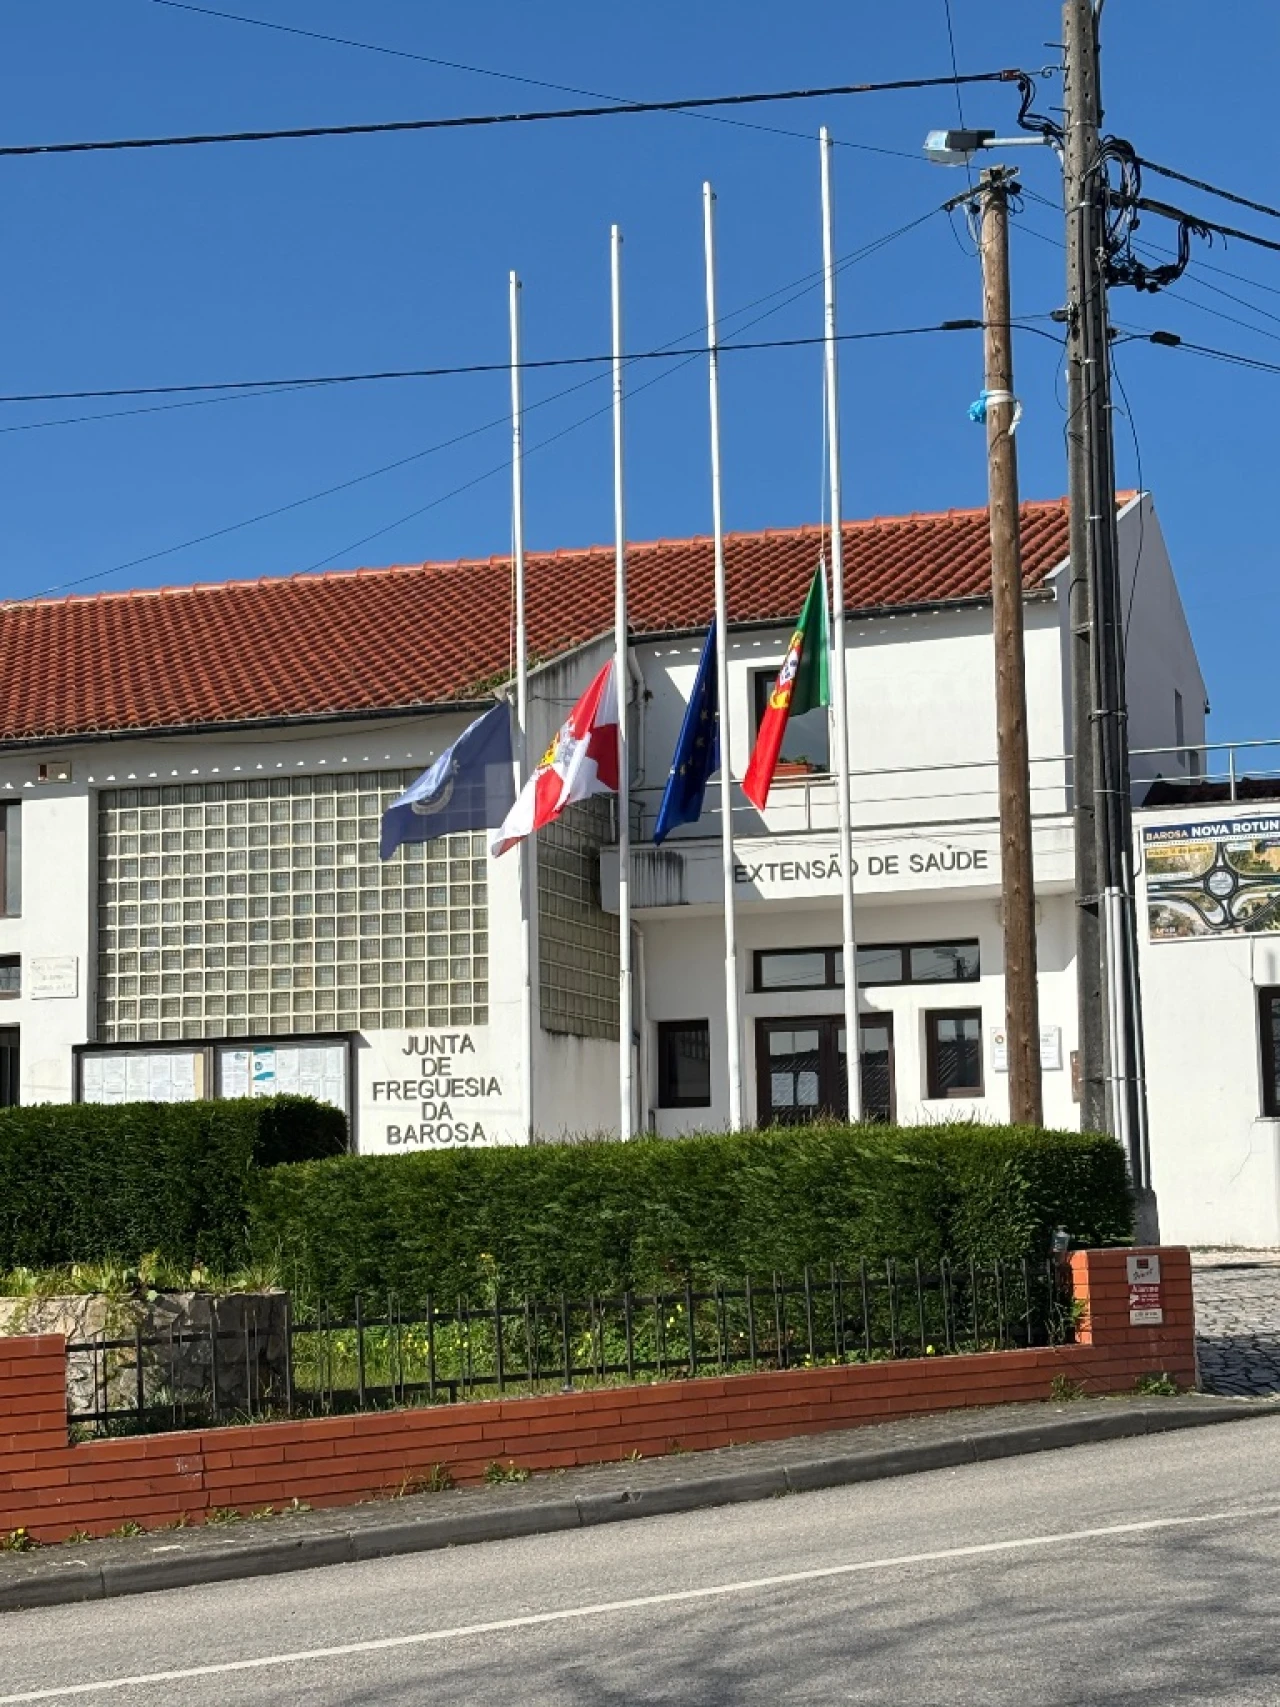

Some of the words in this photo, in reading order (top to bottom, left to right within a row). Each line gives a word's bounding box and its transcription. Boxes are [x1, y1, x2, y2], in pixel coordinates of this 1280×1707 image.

[1191, 824, 1230, 837] NOVA
[868, 855, 899, 876] DE
[909, 845, 988, 873] SAÚDE
[401, 1033, 476, 1056] JUNTA
[421, 1056, 452, 1077] DE
[372, 1077, 502, 1101] FREGUESIA
[421, 1100, 453, 1121] DA
[386, 1122, 487, 1145] BAROSA
